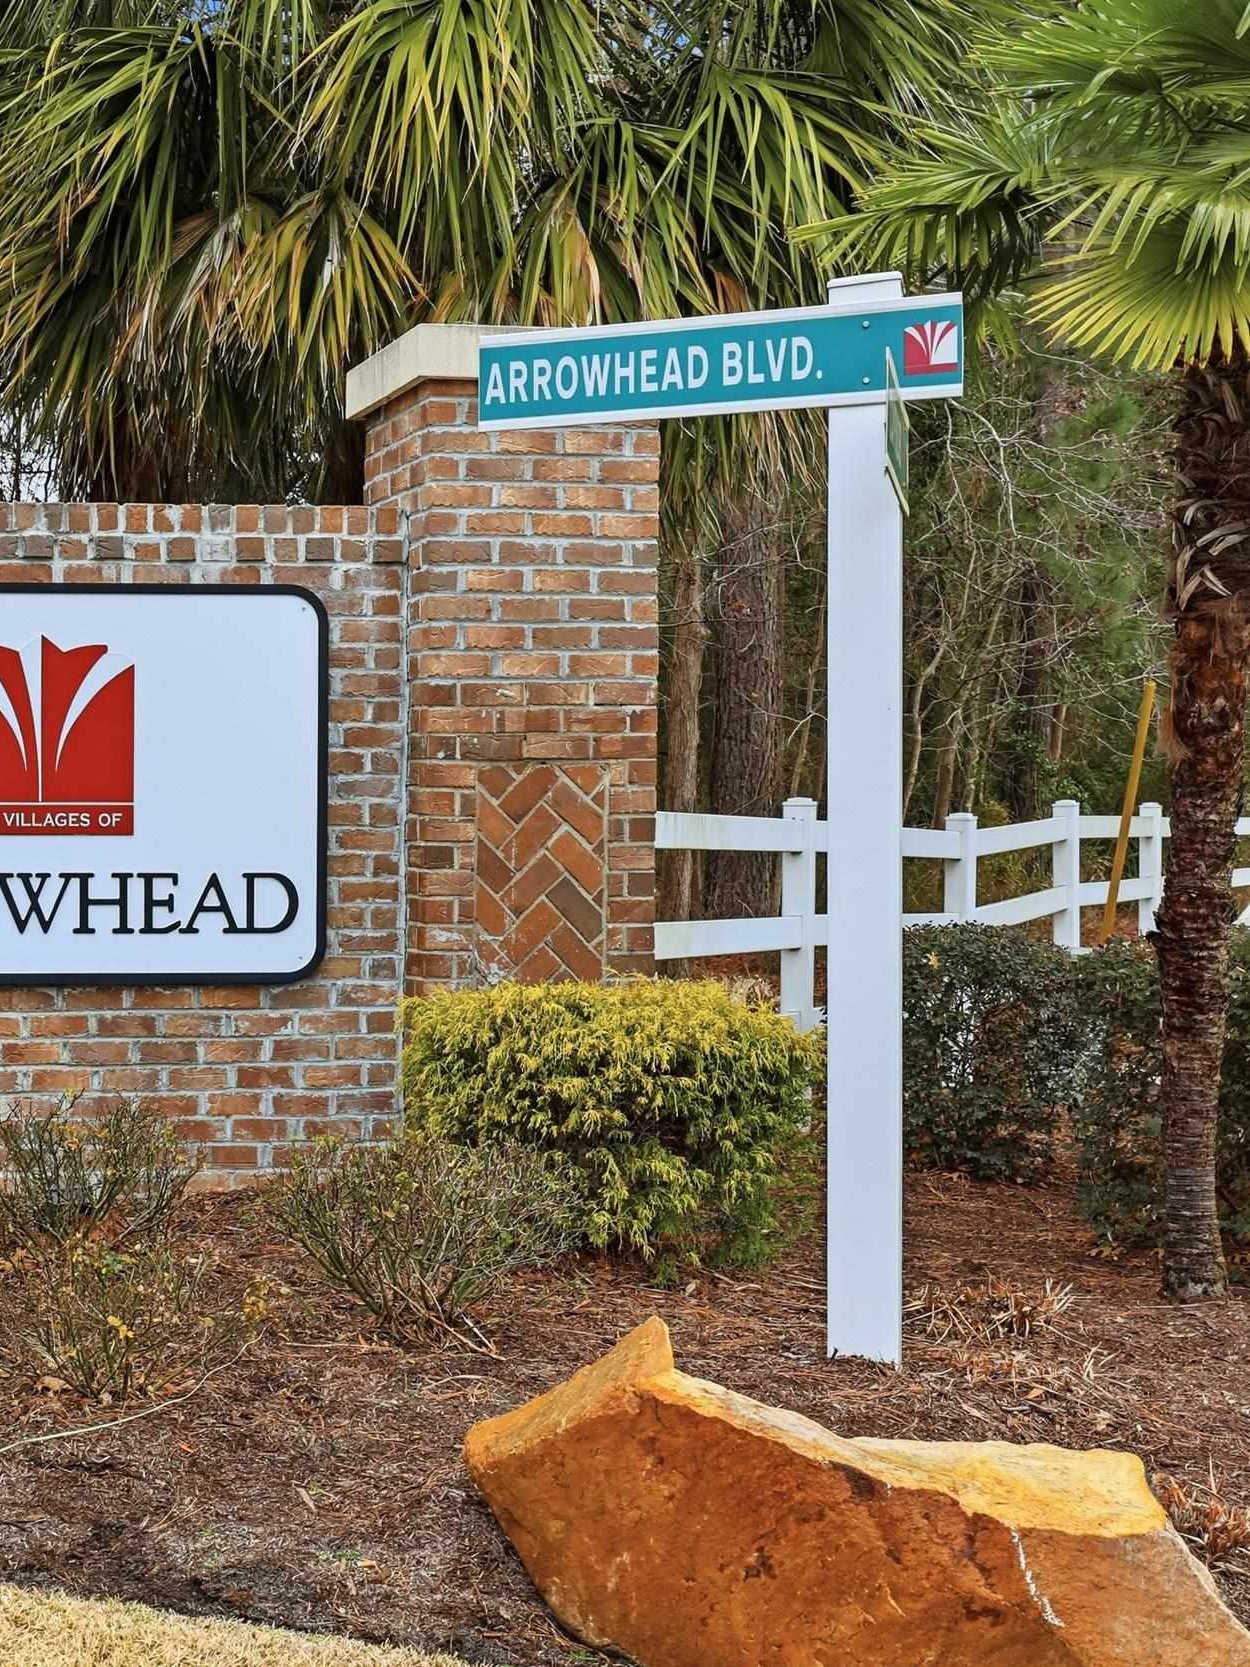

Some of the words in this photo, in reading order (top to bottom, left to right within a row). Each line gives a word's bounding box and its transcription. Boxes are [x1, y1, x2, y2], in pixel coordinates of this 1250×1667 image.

[484, 346, 709, 405] ARROWHEAD
[722, 336, 823, 385] BLVD.
[3, 811, 90, 828] VILLAGES
[98, 811, 122, 827] OF
